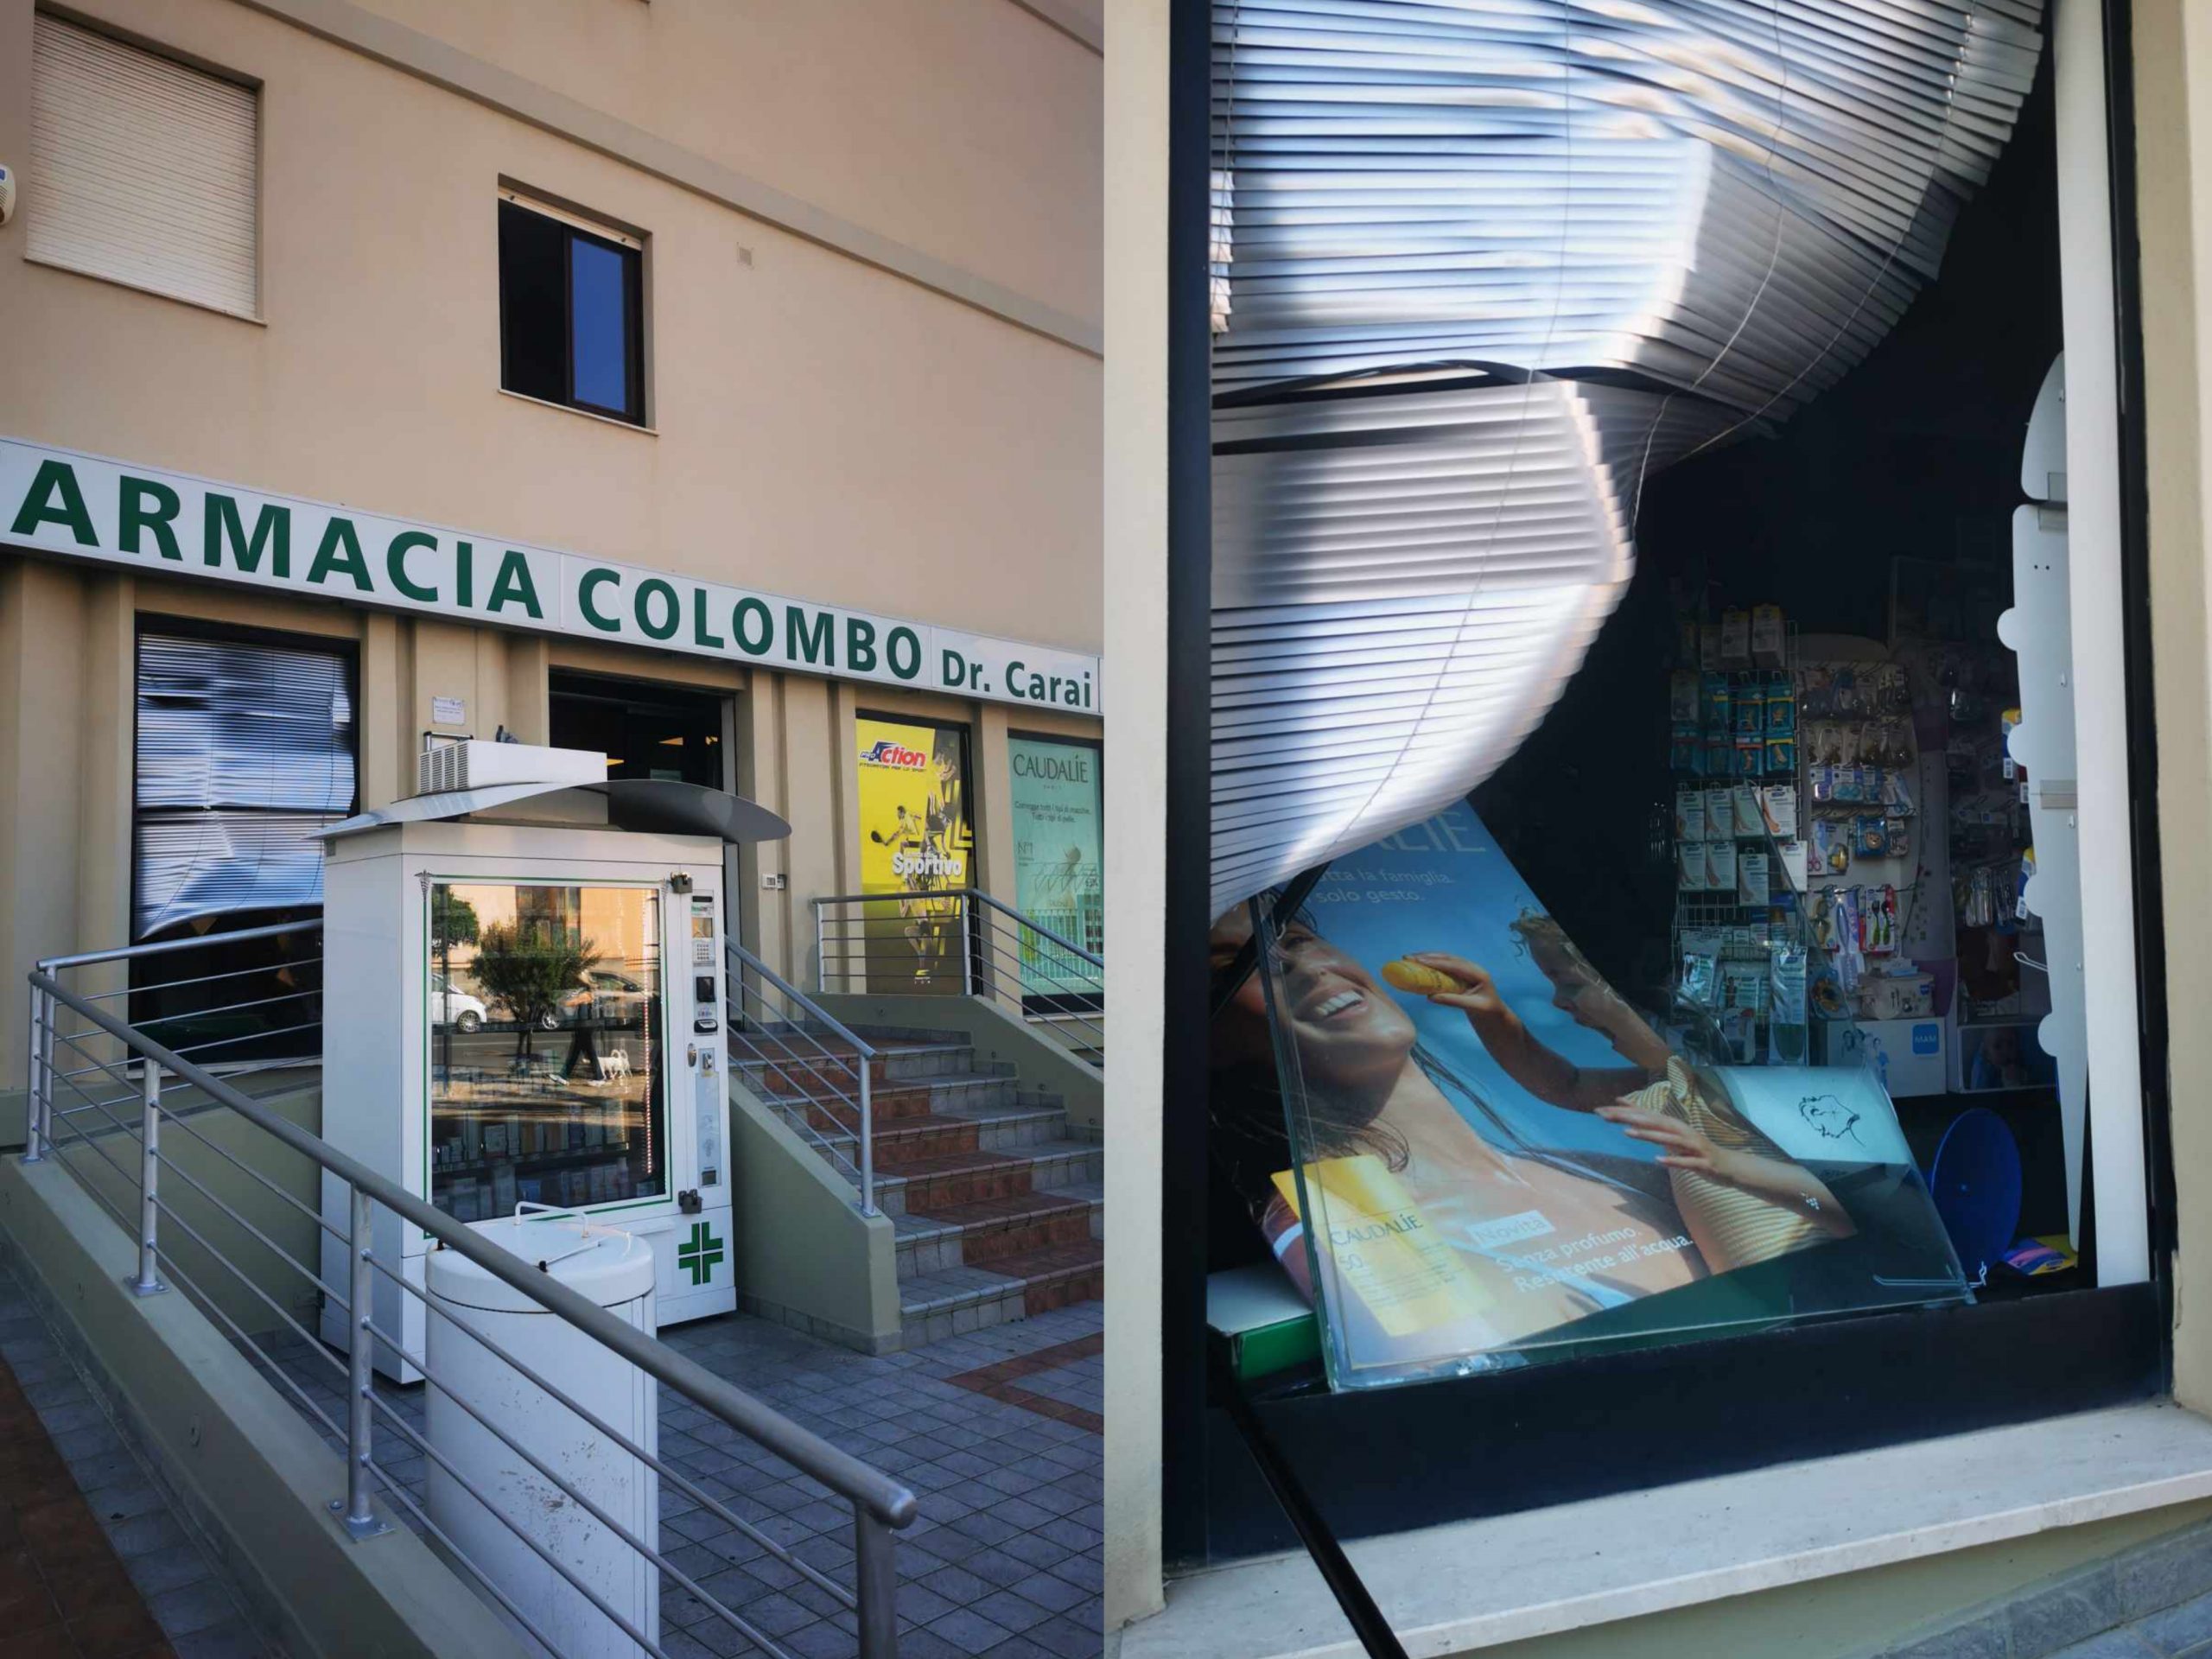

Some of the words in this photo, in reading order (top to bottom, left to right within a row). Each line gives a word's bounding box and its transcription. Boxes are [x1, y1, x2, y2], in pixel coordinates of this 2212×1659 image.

[10, 459, 543, 620] ARMACIA
[578, 568, 922, 680] COLOMBO
[942, 649, 991, 693] Dr.
[1005, 661, 1091, 708] Carai
[893, 851, 963, 880] Sportivo
[1359, 868, 1376, 881] la
[1382, 868, 1456, 887] famiglia.
[1316, 889, 1361, 903] solo
[1366, 891, 1426, 904] gesto.
[1914, 1035, 1936, 1044] MAM
[1560, 1226, 1642, 1259] profumo.
[1617, 1235, 1694, 1264] all'acqua.
